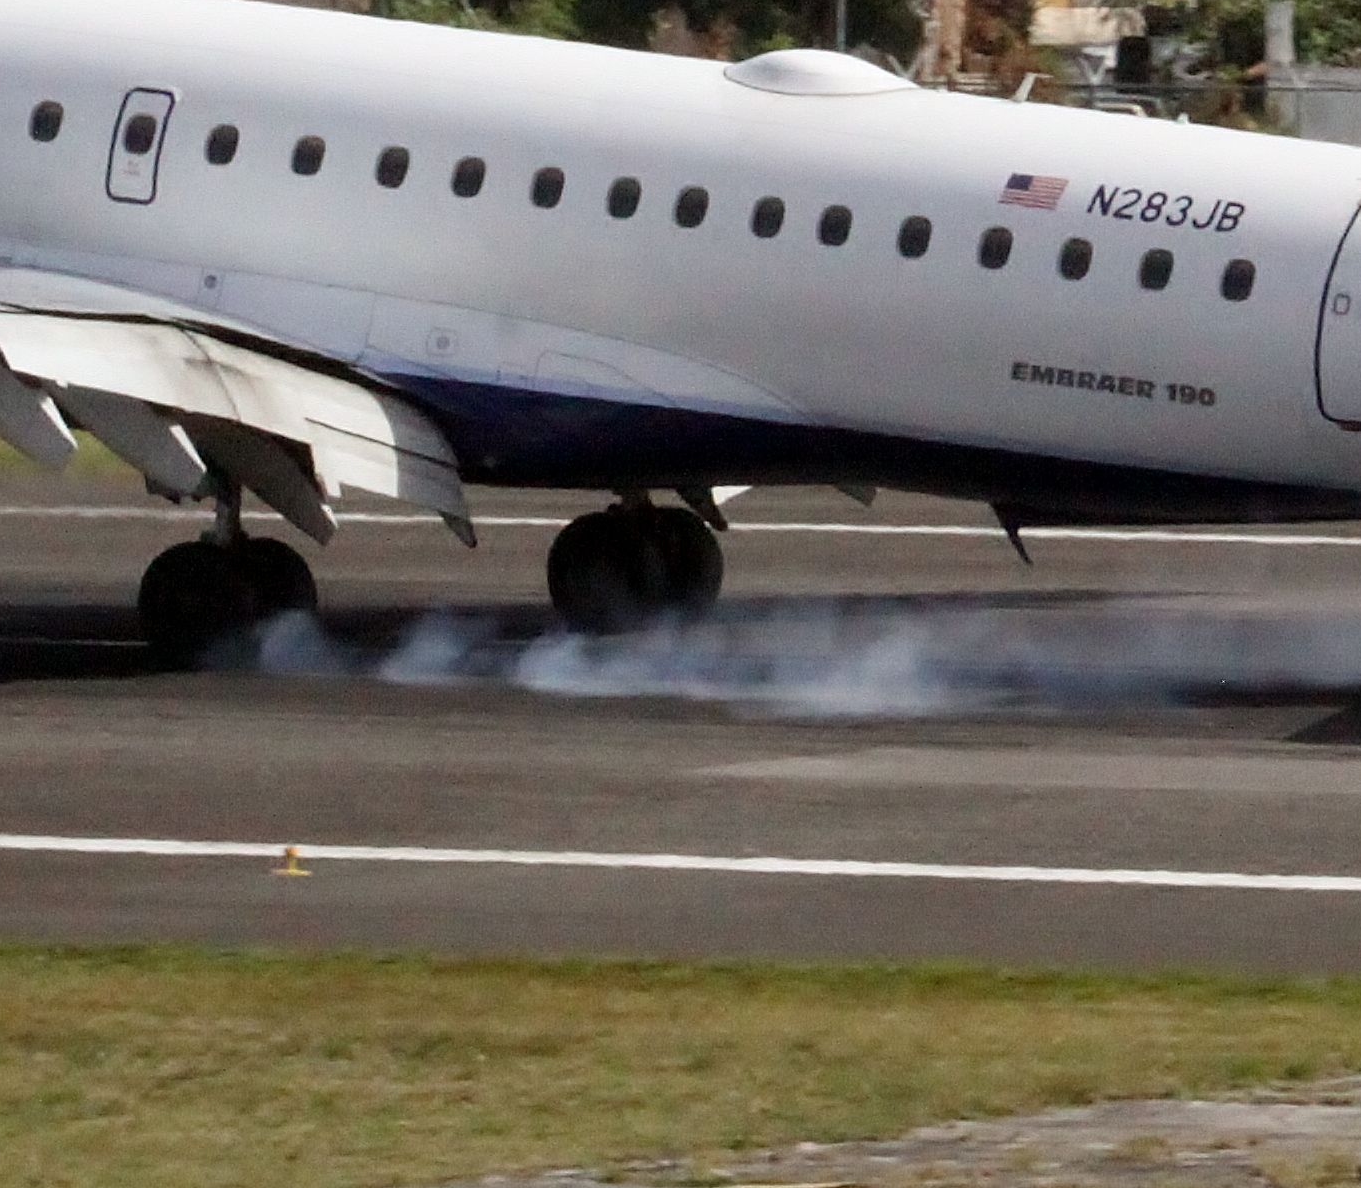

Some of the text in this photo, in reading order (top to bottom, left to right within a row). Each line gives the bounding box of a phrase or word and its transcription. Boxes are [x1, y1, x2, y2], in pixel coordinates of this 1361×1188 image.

[1087, 184, 1245, 232] N283JB
[1011, 361, 1216, 406] EMBRAER 190
